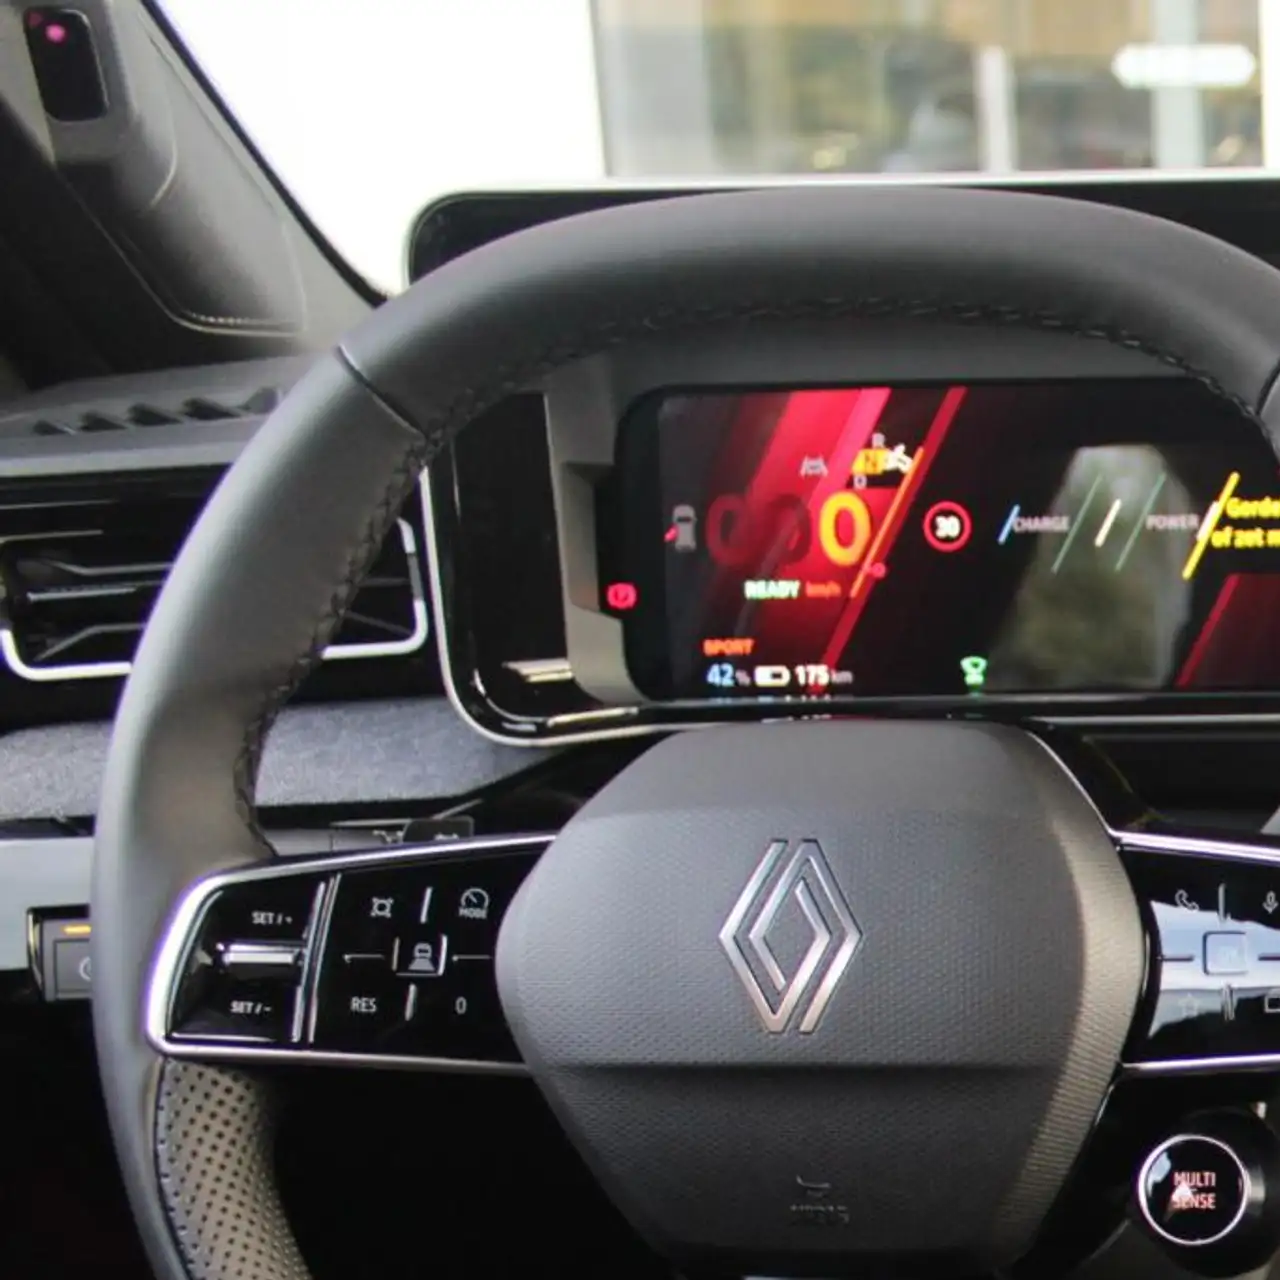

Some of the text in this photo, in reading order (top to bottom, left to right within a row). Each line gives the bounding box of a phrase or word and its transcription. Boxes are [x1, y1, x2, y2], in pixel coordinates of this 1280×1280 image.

[934, 515, 961, 539] 30
[1013, 516, 1070, 533] CHARGE
[1146, 514, 1199, 531] POWER
[744, 579, 801, 599] READY
[703, 639, 754, 656] SPORT
[252, 911, 274, 925] SET
[459, 906, 487, 919] MODE
[230, 1000, 253, 1013] SET
[350, 996, 377, 1013] RES
[1174, 1171, 1217, 1187] MULTI
[1171, 1192, 1217, 1210] SENSE
